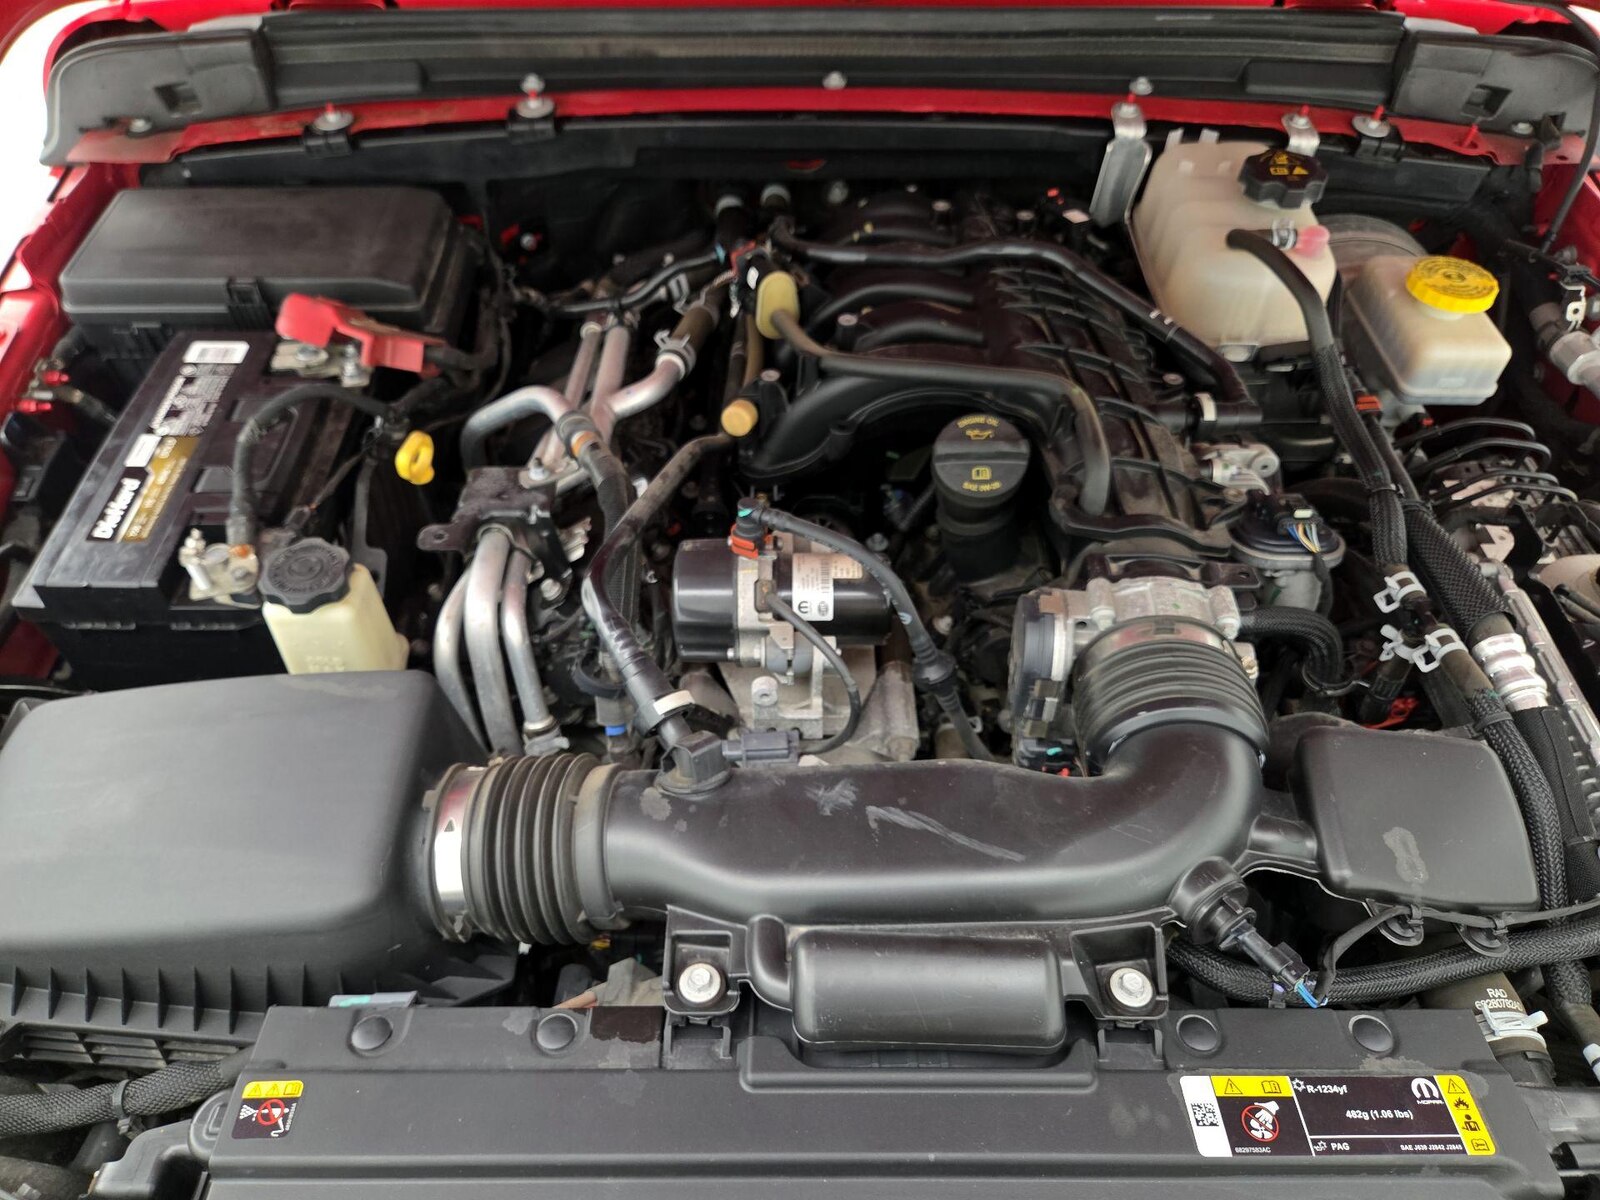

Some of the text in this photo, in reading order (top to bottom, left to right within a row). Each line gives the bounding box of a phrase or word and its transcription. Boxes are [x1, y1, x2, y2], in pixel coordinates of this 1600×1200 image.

[91, 478, 141, 539] DieHard
[1486, 988, 1507, 998] RAD
[1306, 1084, 1348, 1095] R-1234yf
[1370, 1109, 1394, 1120] (1.06
[1394, 1109, 1414, 1120] lbs)
[1330, 1142, 1350, 1151] PAG
